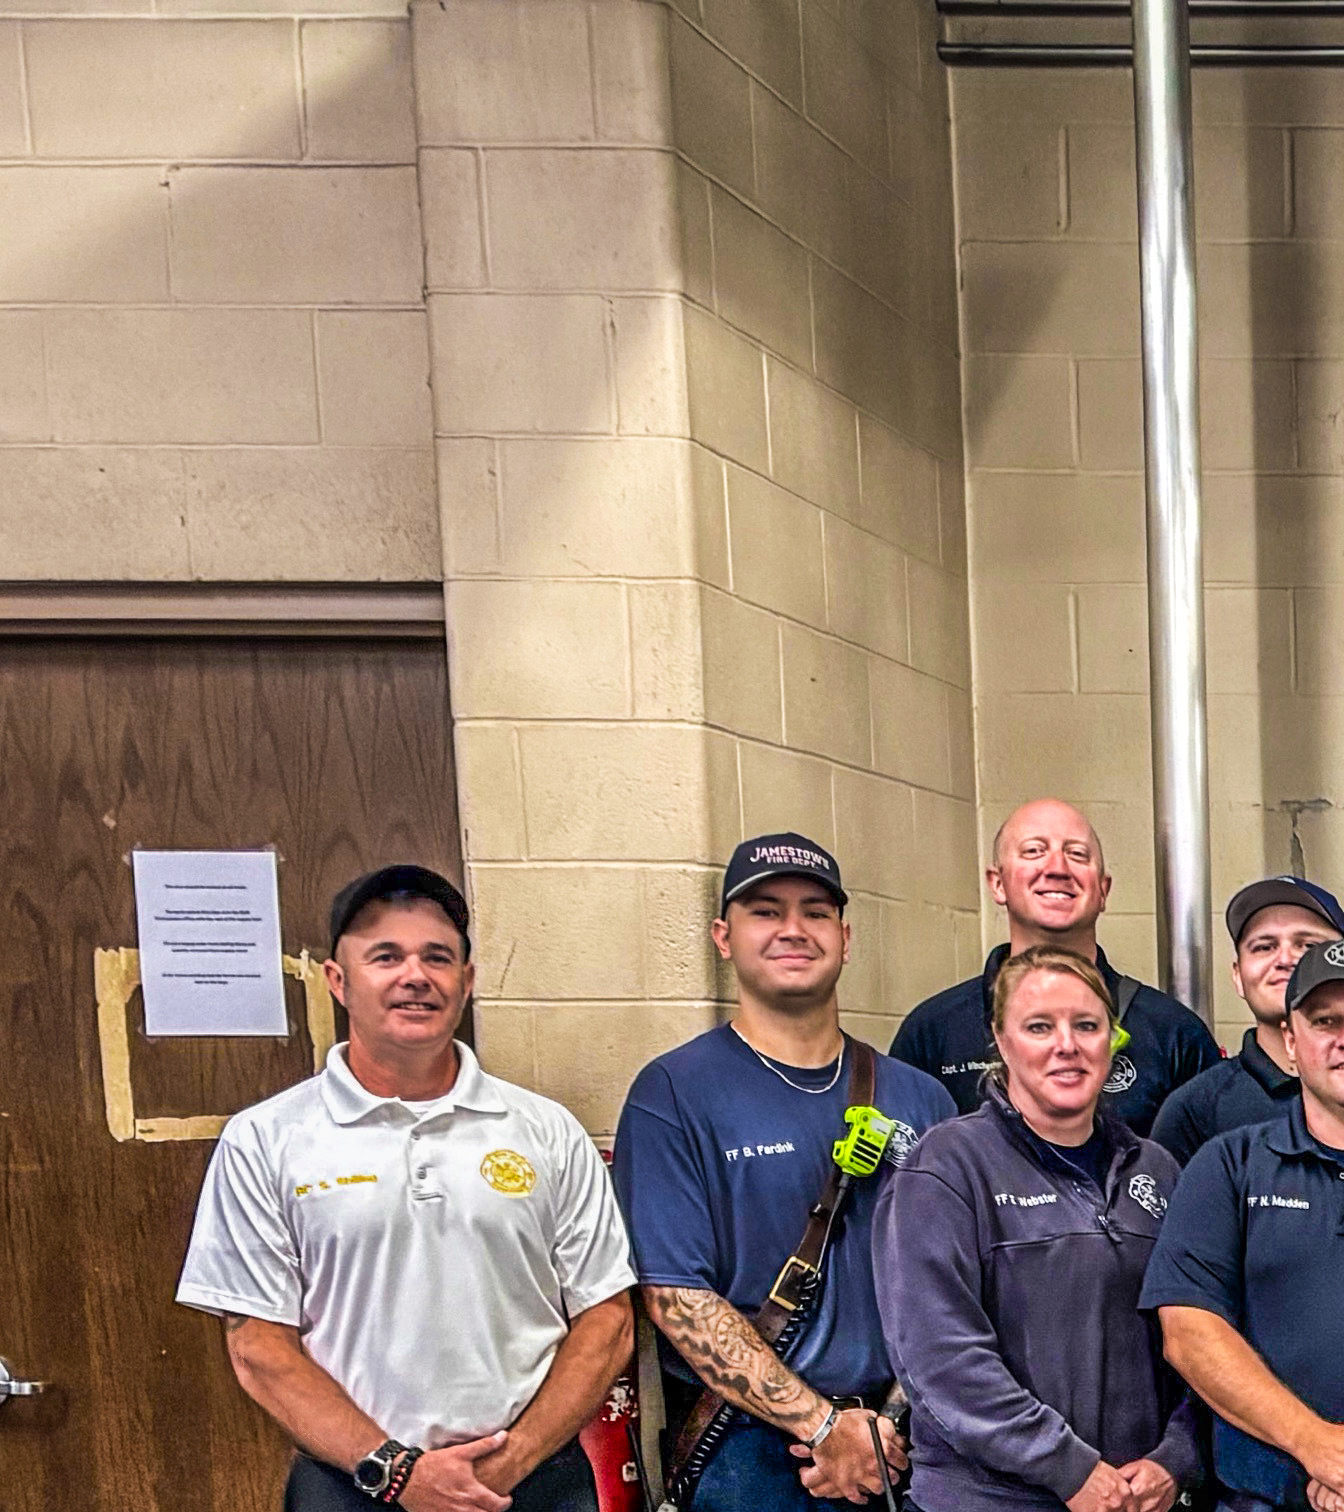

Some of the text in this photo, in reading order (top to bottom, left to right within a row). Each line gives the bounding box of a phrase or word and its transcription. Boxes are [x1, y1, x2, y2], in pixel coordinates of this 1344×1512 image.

[750, 846, 830, 870] JAMESTOWN
[766, 856, 790, 864] FIRE
[725, 1149, 739, 1162] FF
[994, 1193, 1008, 1206] FF
[1271, 1194, 1310, 1210] Madden
